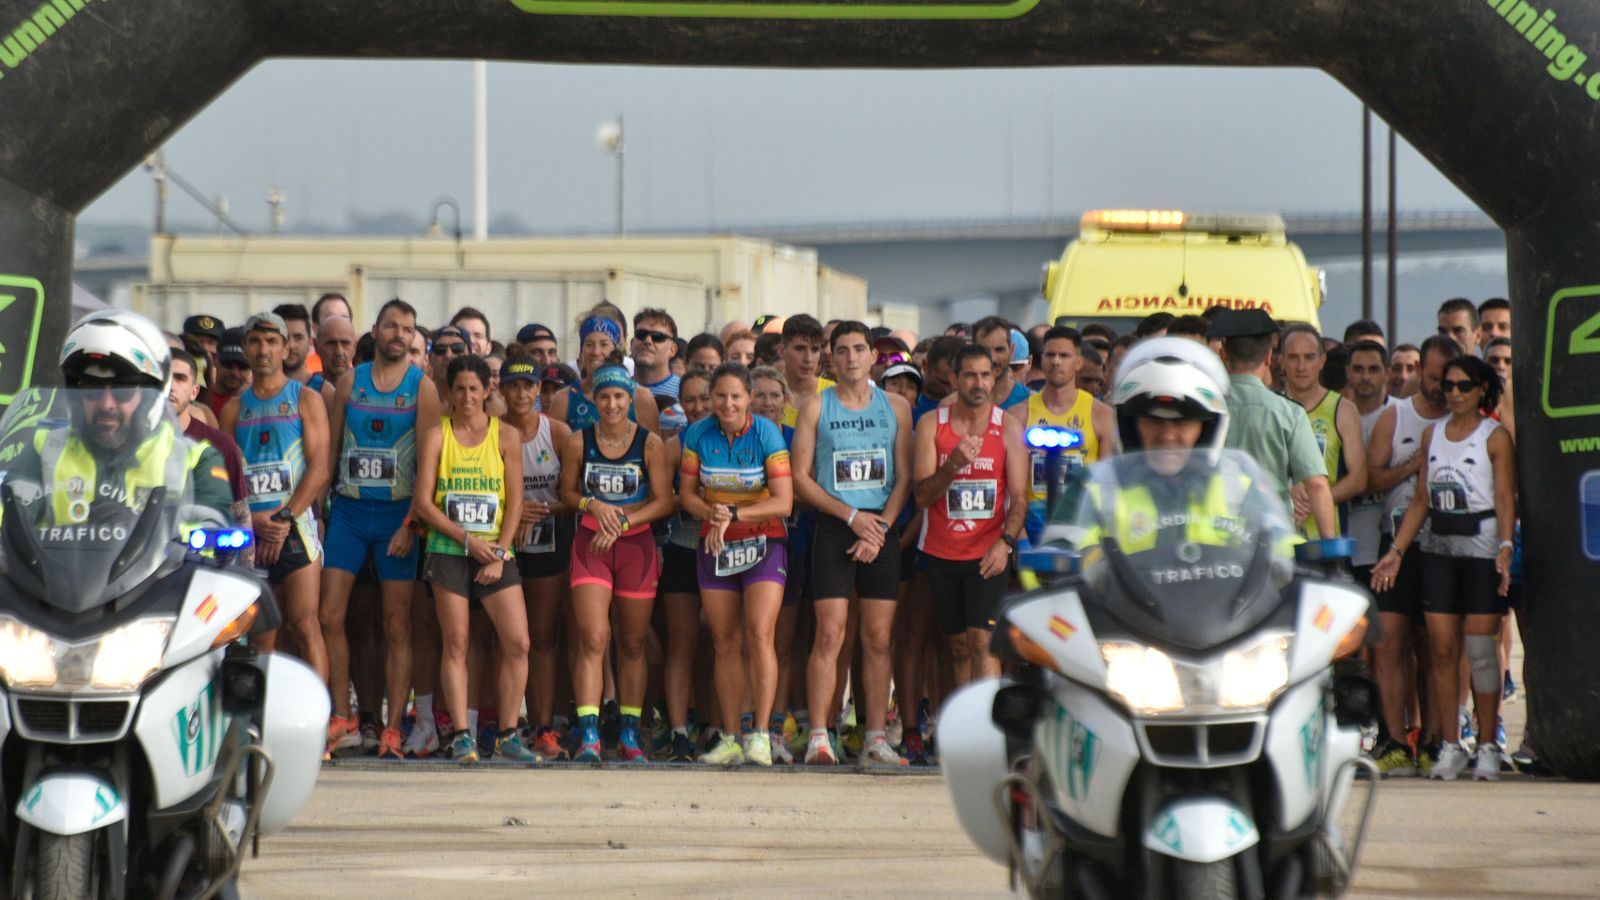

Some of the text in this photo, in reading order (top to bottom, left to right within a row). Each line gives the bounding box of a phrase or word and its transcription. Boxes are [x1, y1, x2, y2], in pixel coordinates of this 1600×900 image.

[829, 416, 876, 431] nerja
[358, 458, 382, 478] 36
[850, 460, 872, 481] 67
[251, 472, 282, 494] 124
[438, 475, 502, 492] BARREÑOS
[599, 475, 623, 493] 56
[99, 483, 143, 516] CIVIL
[960, 489, 986, 511] 84
[1438, 490, 1456, 510] 10
[455, 502, 489, 524] 154
[40, 527, 128, 541] TRAFICO
[725, 546, 757, 568] 150
[1154, 564, 1245, 585] TRAFICO
